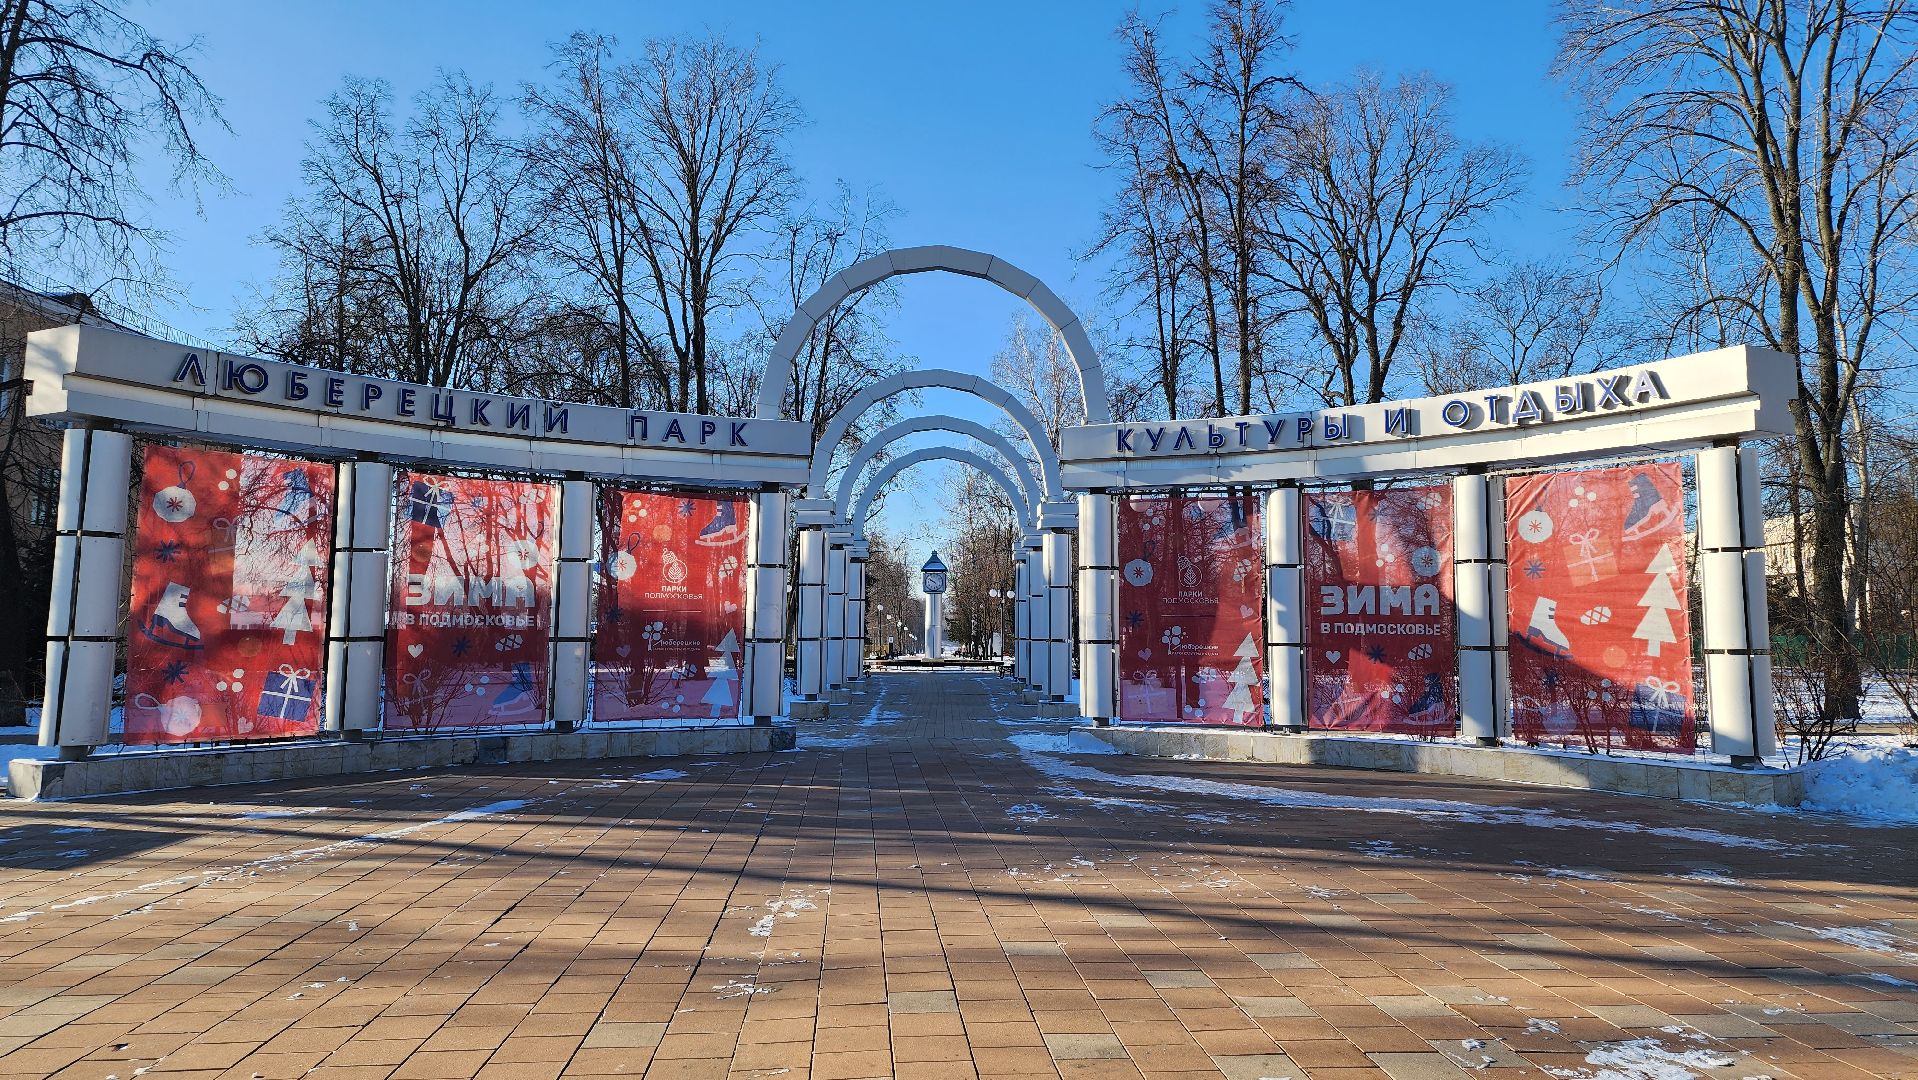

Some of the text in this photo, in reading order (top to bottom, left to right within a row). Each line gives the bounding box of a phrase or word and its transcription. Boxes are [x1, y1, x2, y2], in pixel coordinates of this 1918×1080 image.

[174, 351, 748, 447] ЛЮБЕРЕЦКИЙ ПАРК
[1116, 369, 1659, 453] КУЛЬТУРЫ И ОТДЫХА
[405, 573, 536, 607] ЗИМА
[1320, 583, 1441, 616] ЗИМА
[405, 612, 535, 628] В ПОДМОСКОВЬЕ
[1320, 622, 1441, 636] В ПОДМОСКОВЬЕ
